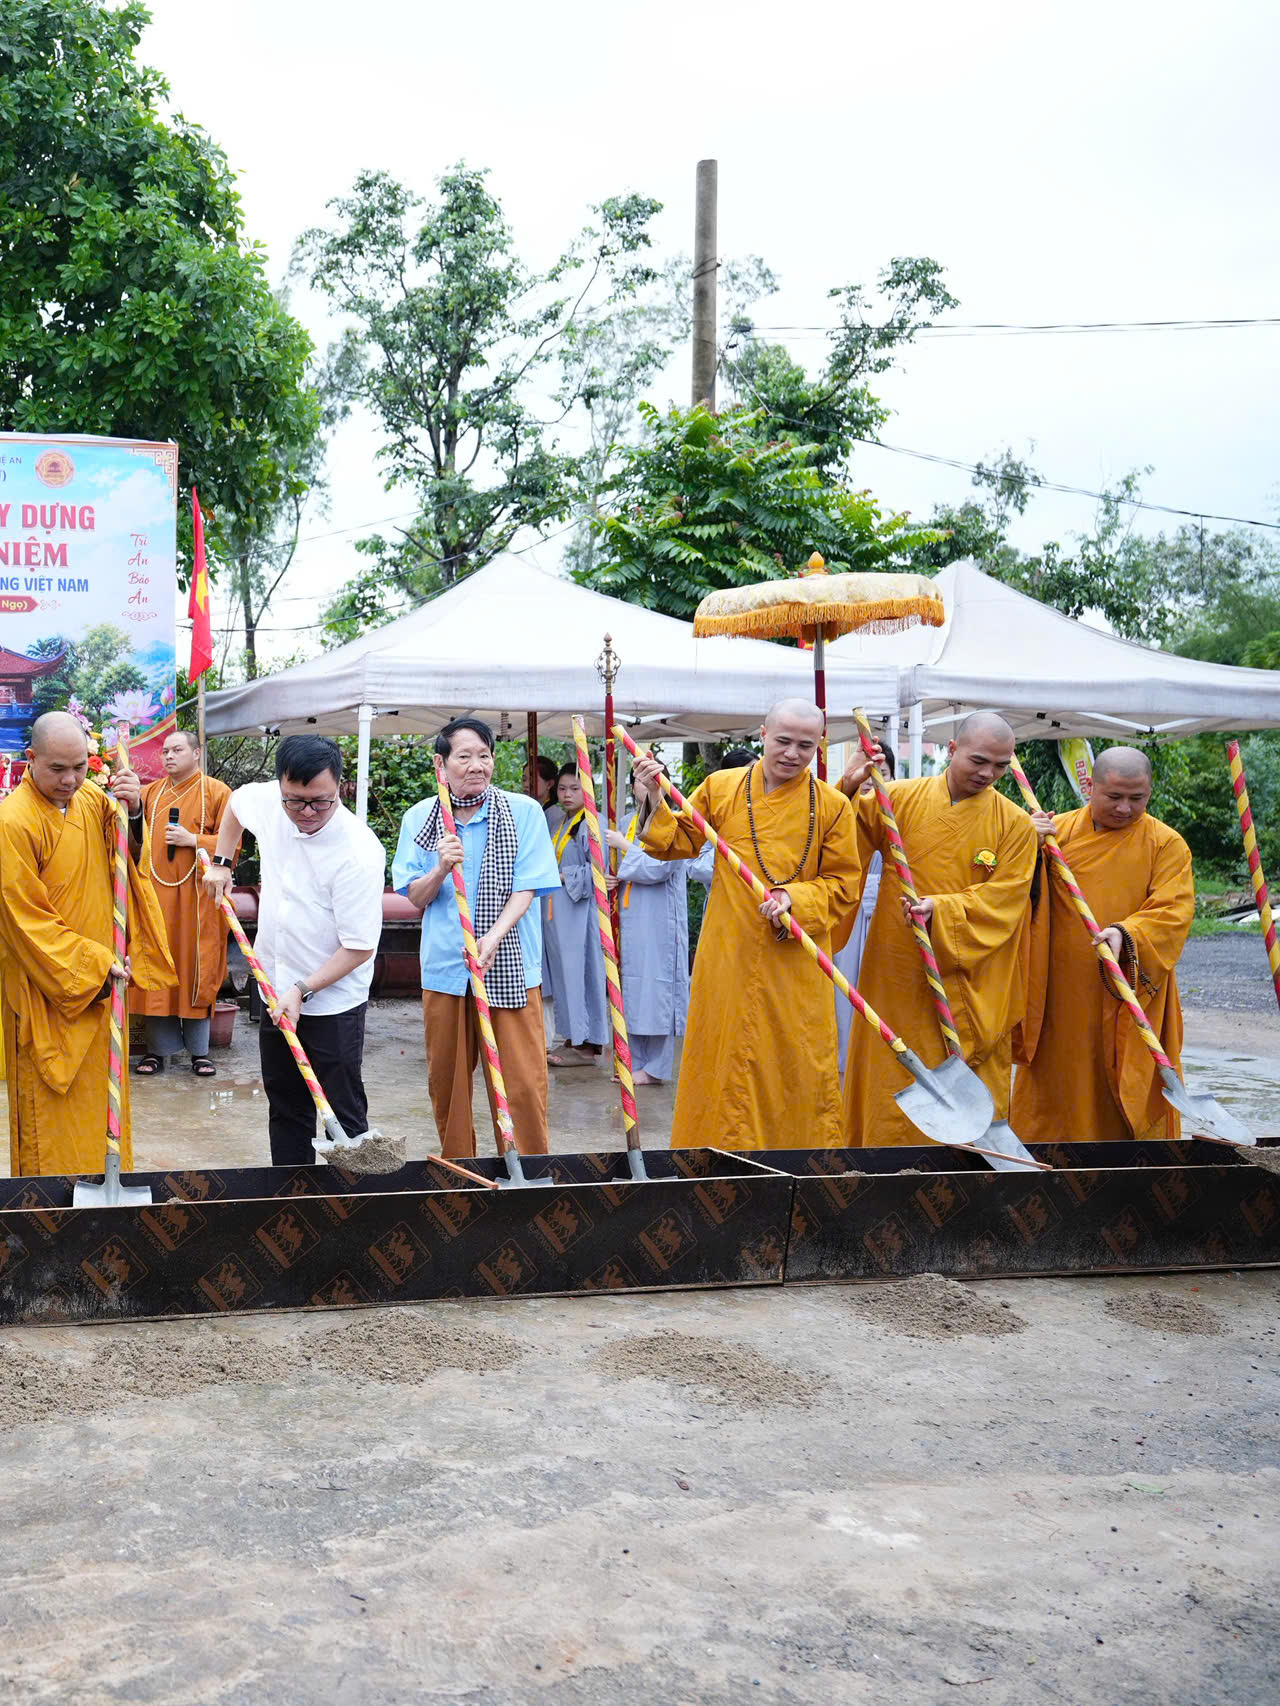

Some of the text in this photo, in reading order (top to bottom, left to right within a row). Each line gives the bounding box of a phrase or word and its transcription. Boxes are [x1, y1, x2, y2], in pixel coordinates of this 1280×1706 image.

[21, 502, 96, 535] DỰNG
[23, 575, 54, 593] VIỆT
[57, 578, 89, 592] NAM
[1, 600, 29, 611] Ngọ)
